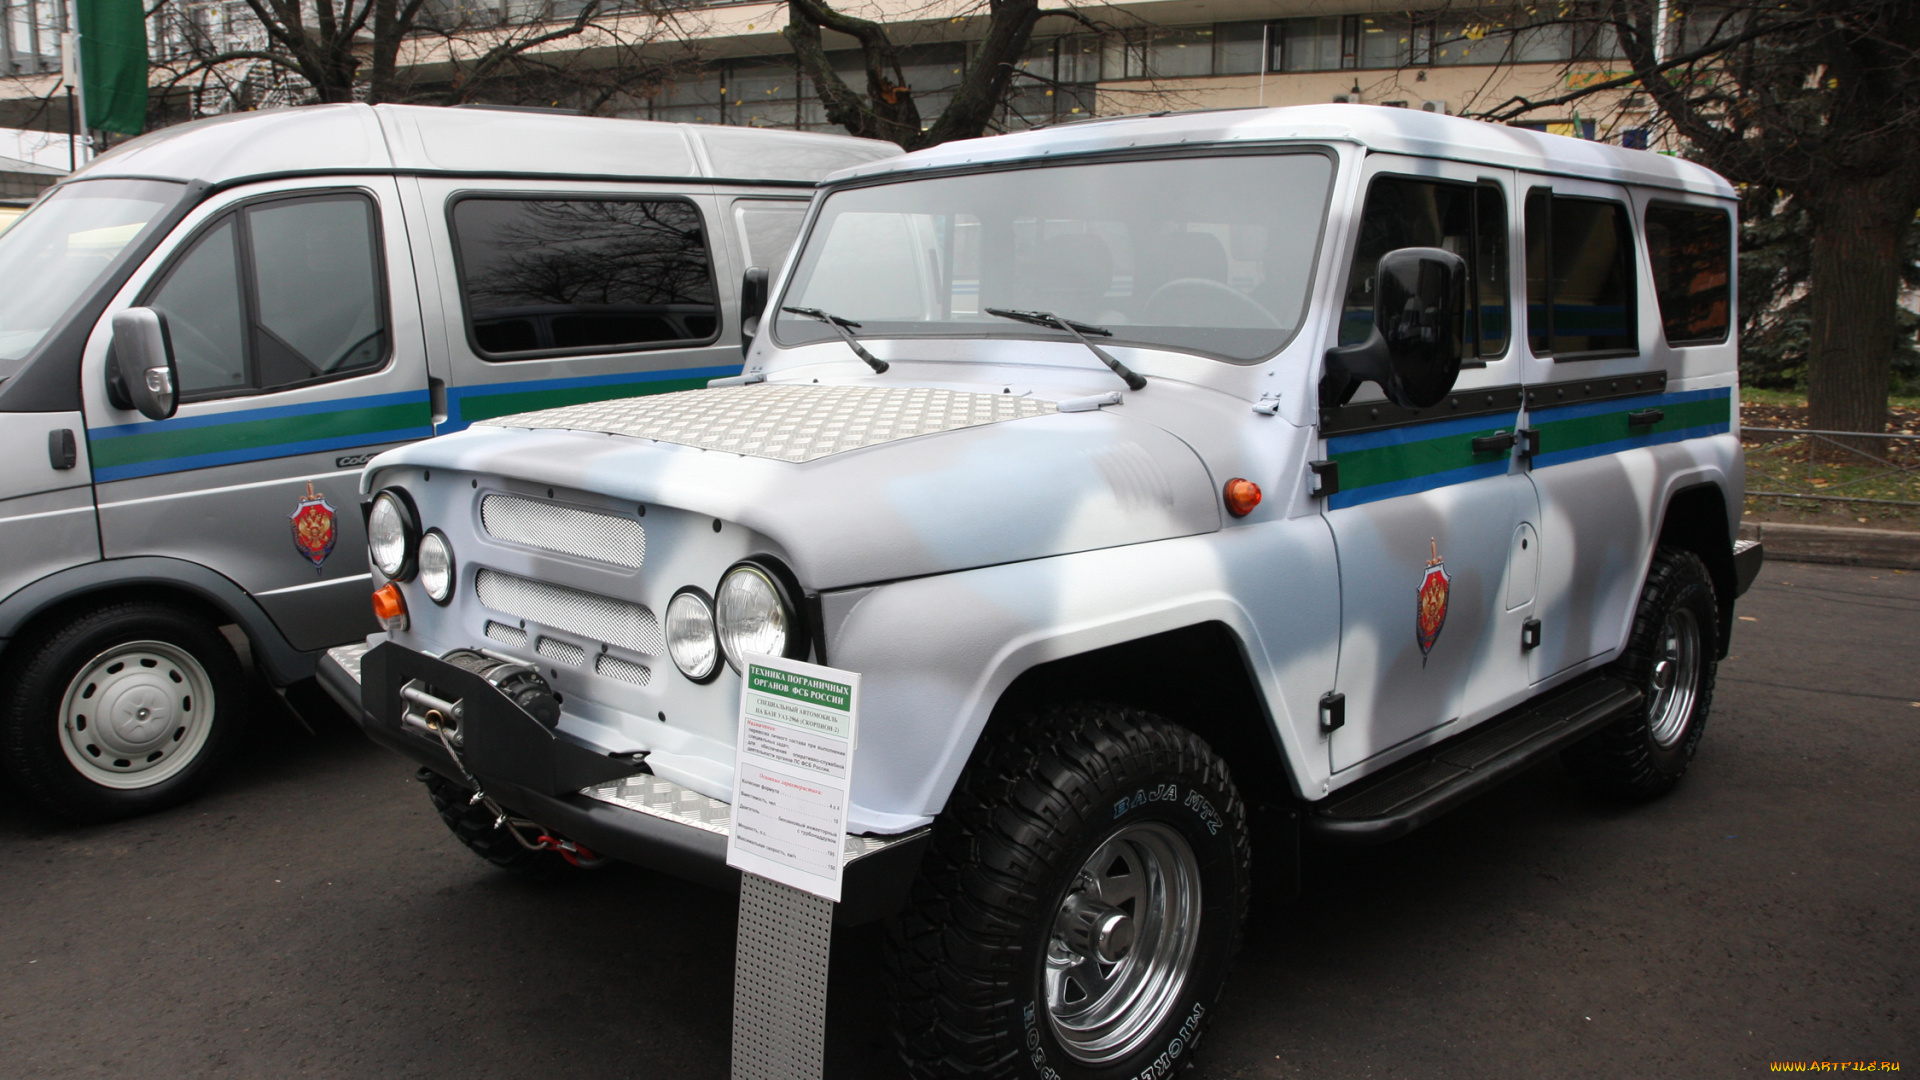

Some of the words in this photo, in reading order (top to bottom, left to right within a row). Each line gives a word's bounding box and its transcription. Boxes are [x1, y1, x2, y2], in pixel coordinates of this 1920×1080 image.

[750, 665, 786, 681] ТЕХНИКА
[787, 674, 849, 696] ПОГРАНИЧНЫХ
[754, 678, 789, 692] ОРГАНОВ
[792, 686, 809, 698] ФСБ
[810, 690, 844, 705] РОССИИ
[755, 707, 763, 715] НА
[764, 709, 776, 718] БАЗЕ
[800, 718, 840, 734] (СКОРПИОН-2)
[756, 698, 798, 713] СПЕЦИАЛЬНЫЙ
[799, 708, 838, 723] АВТОМОБИЛЬ
[801, 760, 812, 768] ФСБ
[1113, 784, 1177, 819] BAJA
[1184, 789, 1223, 835] MTZ
[1023, 1001, 1062, 1080] PSON
[1130, 1002, 1206, 1080] MICKE
